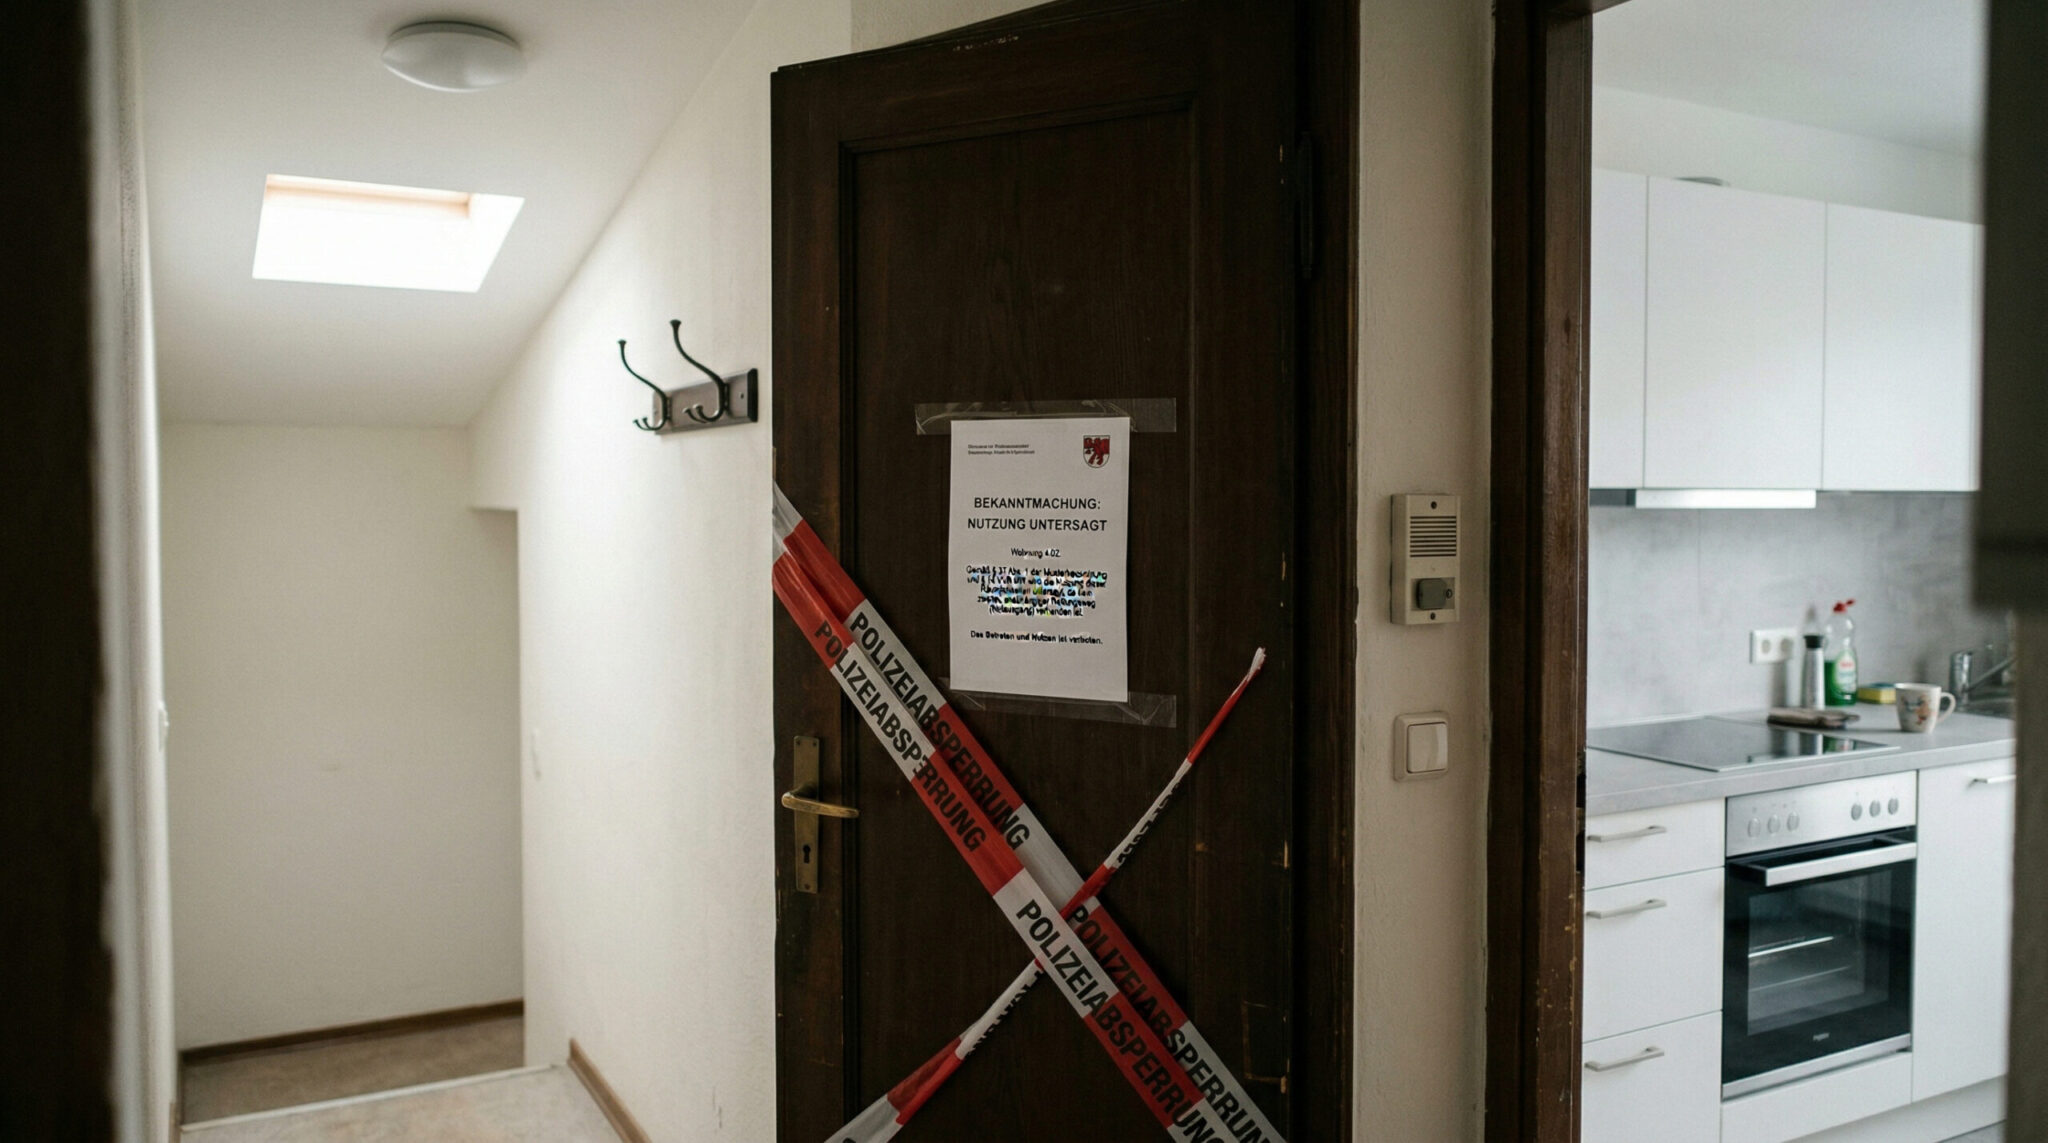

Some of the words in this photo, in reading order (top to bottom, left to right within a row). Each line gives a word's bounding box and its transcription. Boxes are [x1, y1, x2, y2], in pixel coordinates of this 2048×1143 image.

[967, 518, 1026, 530] NUTZUNG
[1029, 519, 1107, 531] UNTERSAGT
[974, 497, 1101, 509] BEKANNTMACHUNG:
[849, 611, 1030, 850] POLIZEIABSPERRUNG
[1016, 899, 1224, 1143] POLIZEIABSPERRUN
